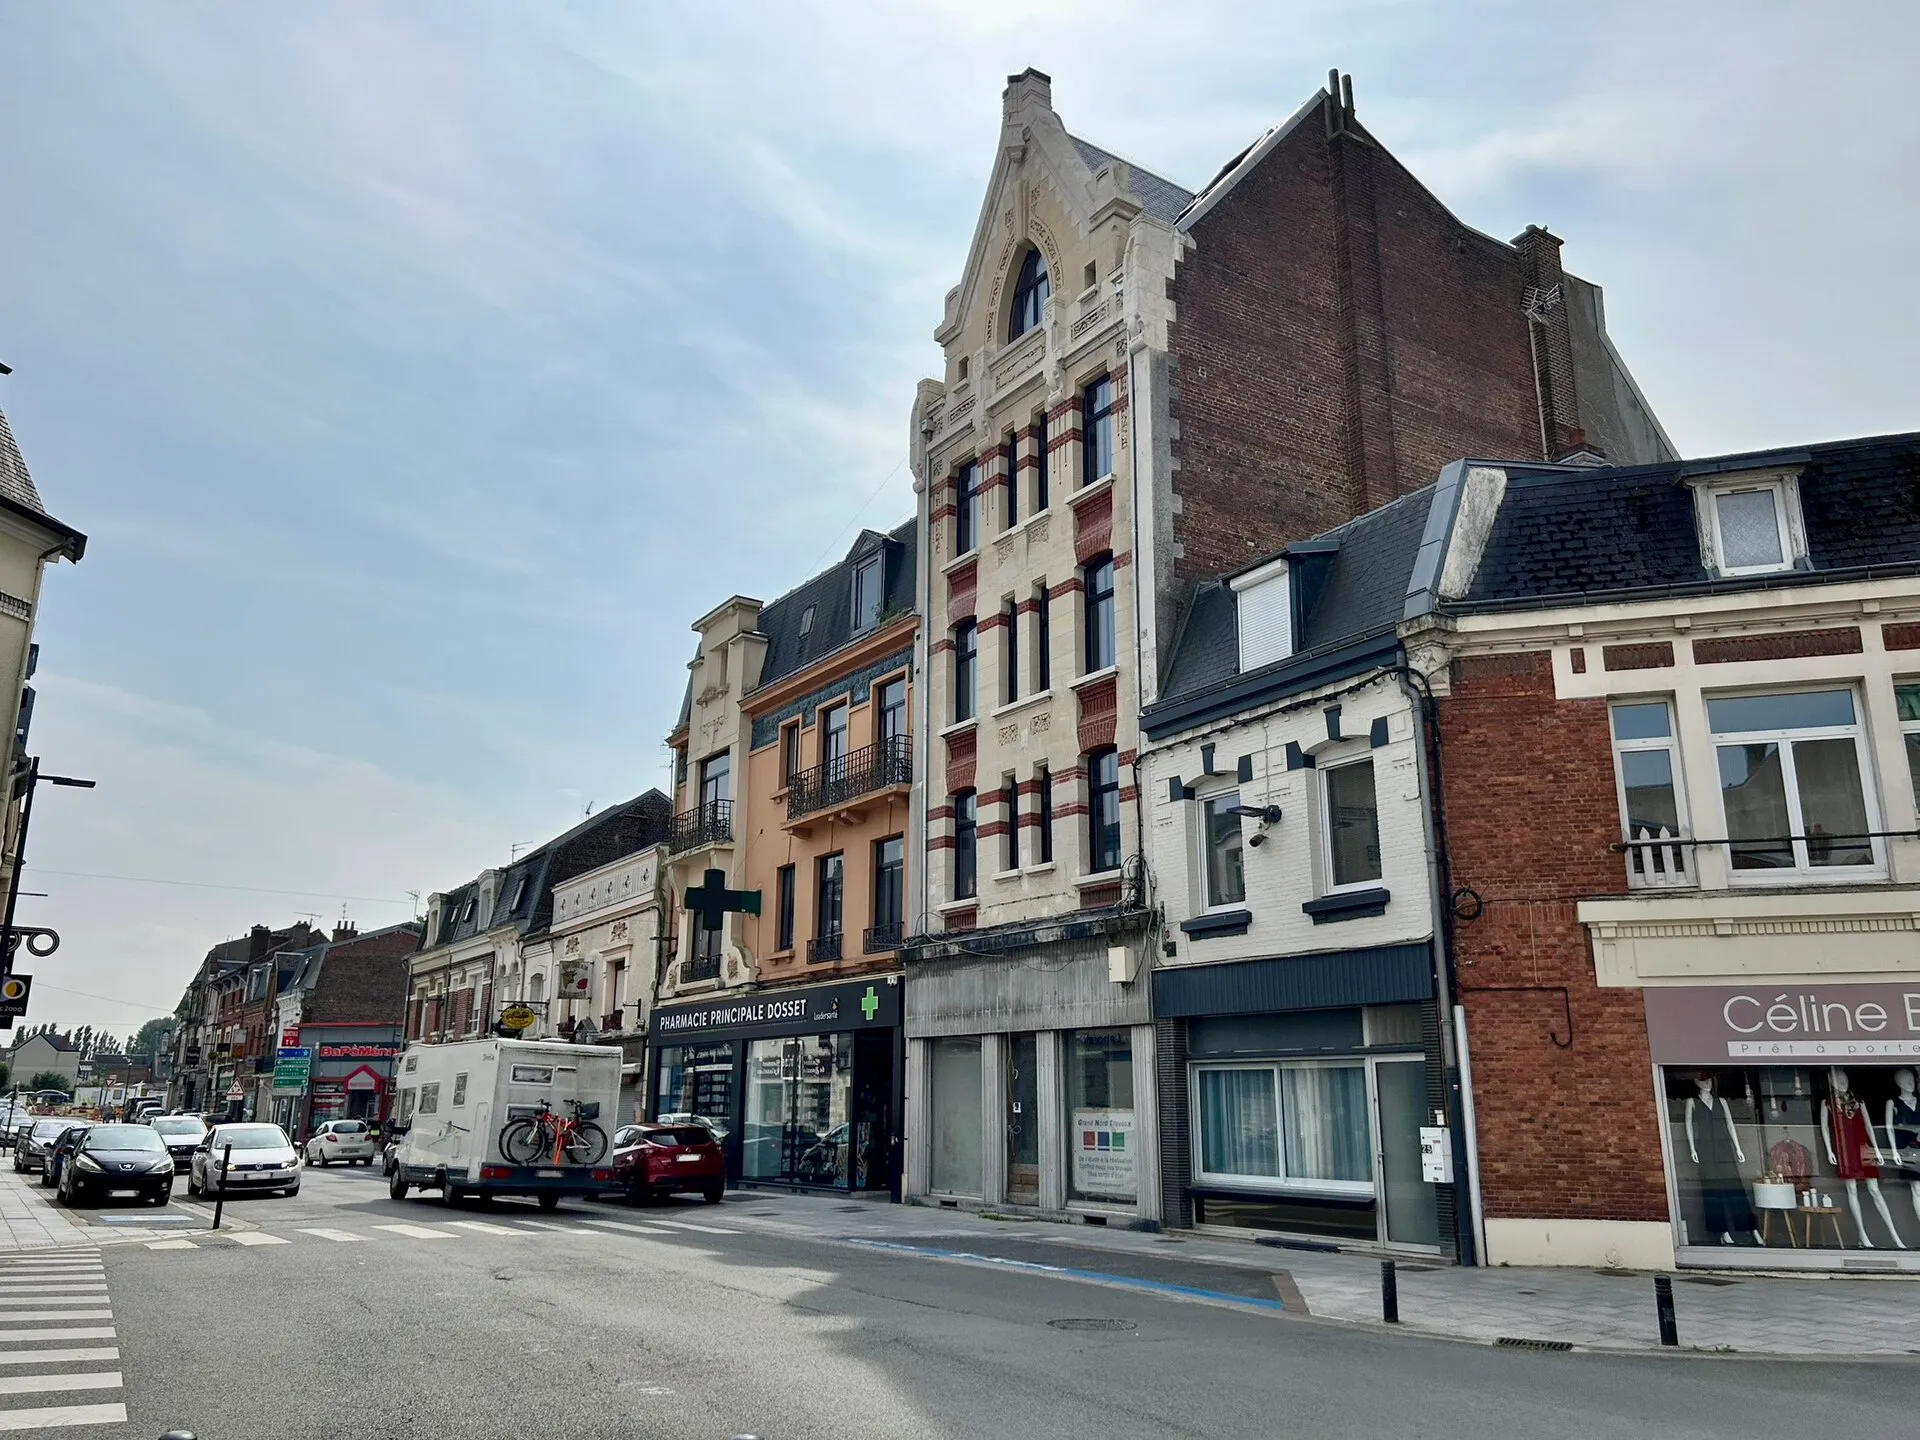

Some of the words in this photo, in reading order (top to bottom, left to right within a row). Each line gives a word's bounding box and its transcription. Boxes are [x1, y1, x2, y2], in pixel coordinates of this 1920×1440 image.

[660, 1012, 707, 1030] PHARMACIE
[710, 1005, 764, 1025] PRINCIPALE
[767, 999, 807, 1019] DOSSET
[1723, 993, 1888, 1033] Céline
[1741, 1043, 1794, 1054] Prêt
[1816, 1043, 1825, 1053] à
